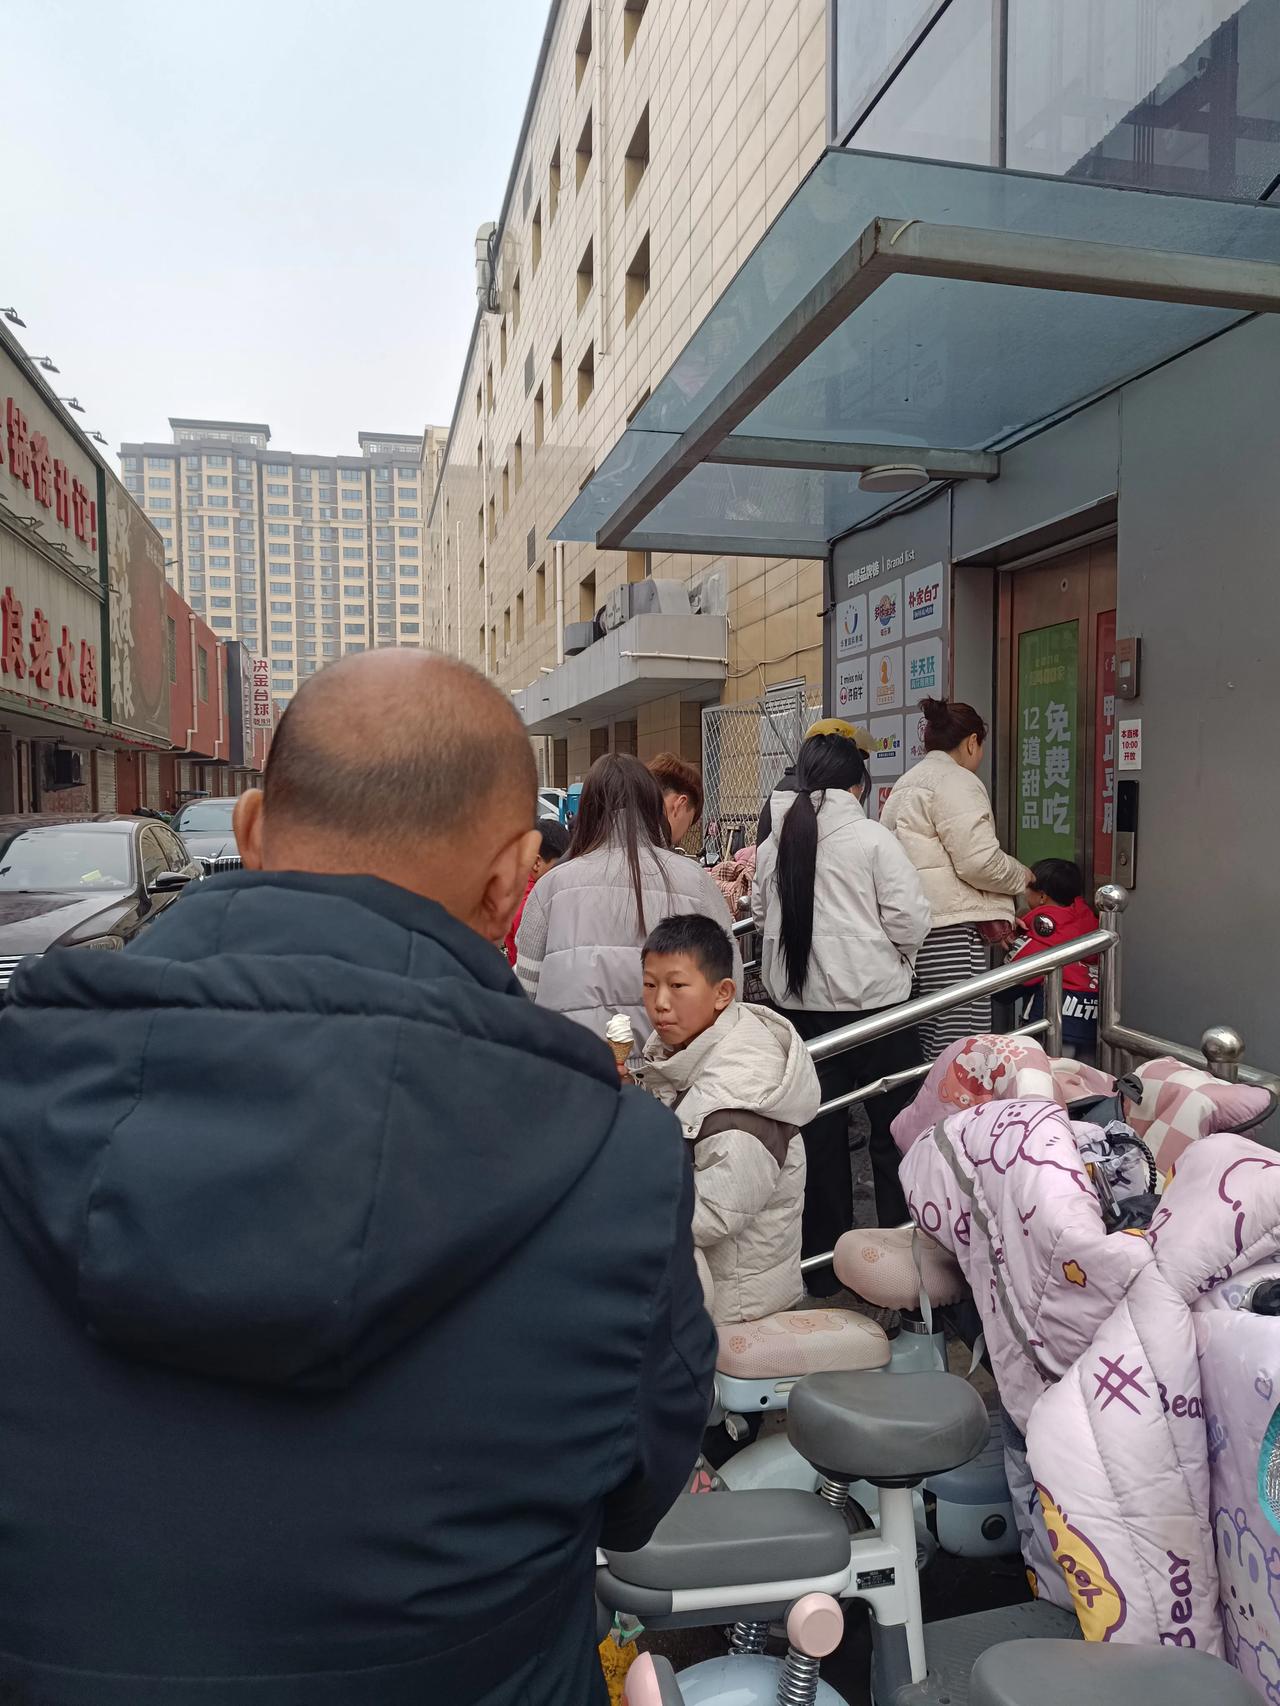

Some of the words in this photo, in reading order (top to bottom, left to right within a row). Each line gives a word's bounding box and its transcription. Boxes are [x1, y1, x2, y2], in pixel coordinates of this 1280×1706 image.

[0, 397, 97, 552] 锅徐升记!
[886, 552, 904, 570] Brand
[905, 549, 916, 562] list
[844, 673, 854, 684] miss
[1122, 740, 1138, 749] 10:00
[1124, 752, 1136, 761] 开放
[1043, 701, 1071, 834] 免费吃
